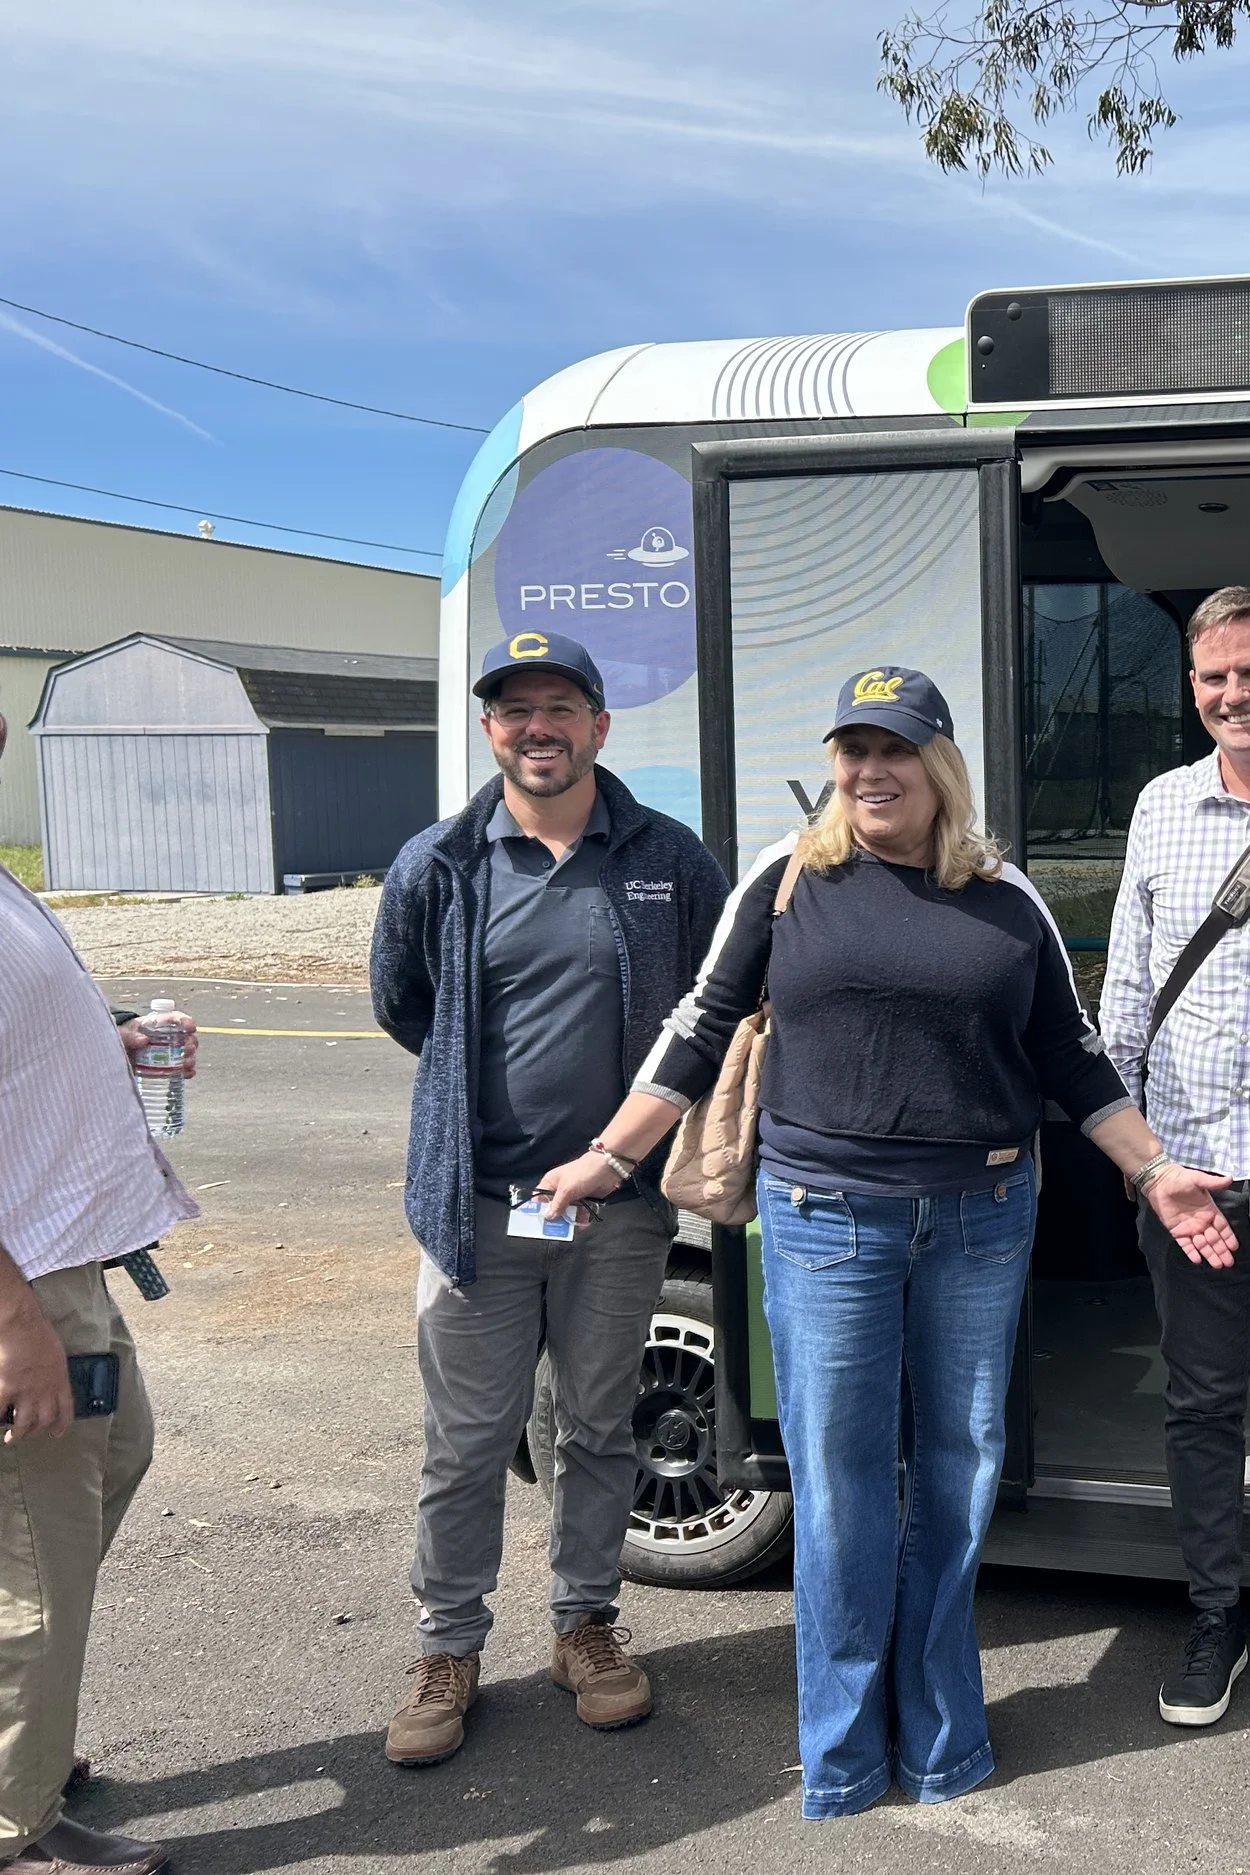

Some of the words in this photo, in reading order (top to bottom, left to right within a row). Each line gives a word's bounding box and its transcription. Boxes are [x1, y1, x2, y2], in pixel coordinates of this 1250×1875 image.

[520, 581, 690, 611] PRESTO
[509, 632, 549, 659] C
[852, 671, 904, 706] Cal
[624, 881, 641, 890] UC
